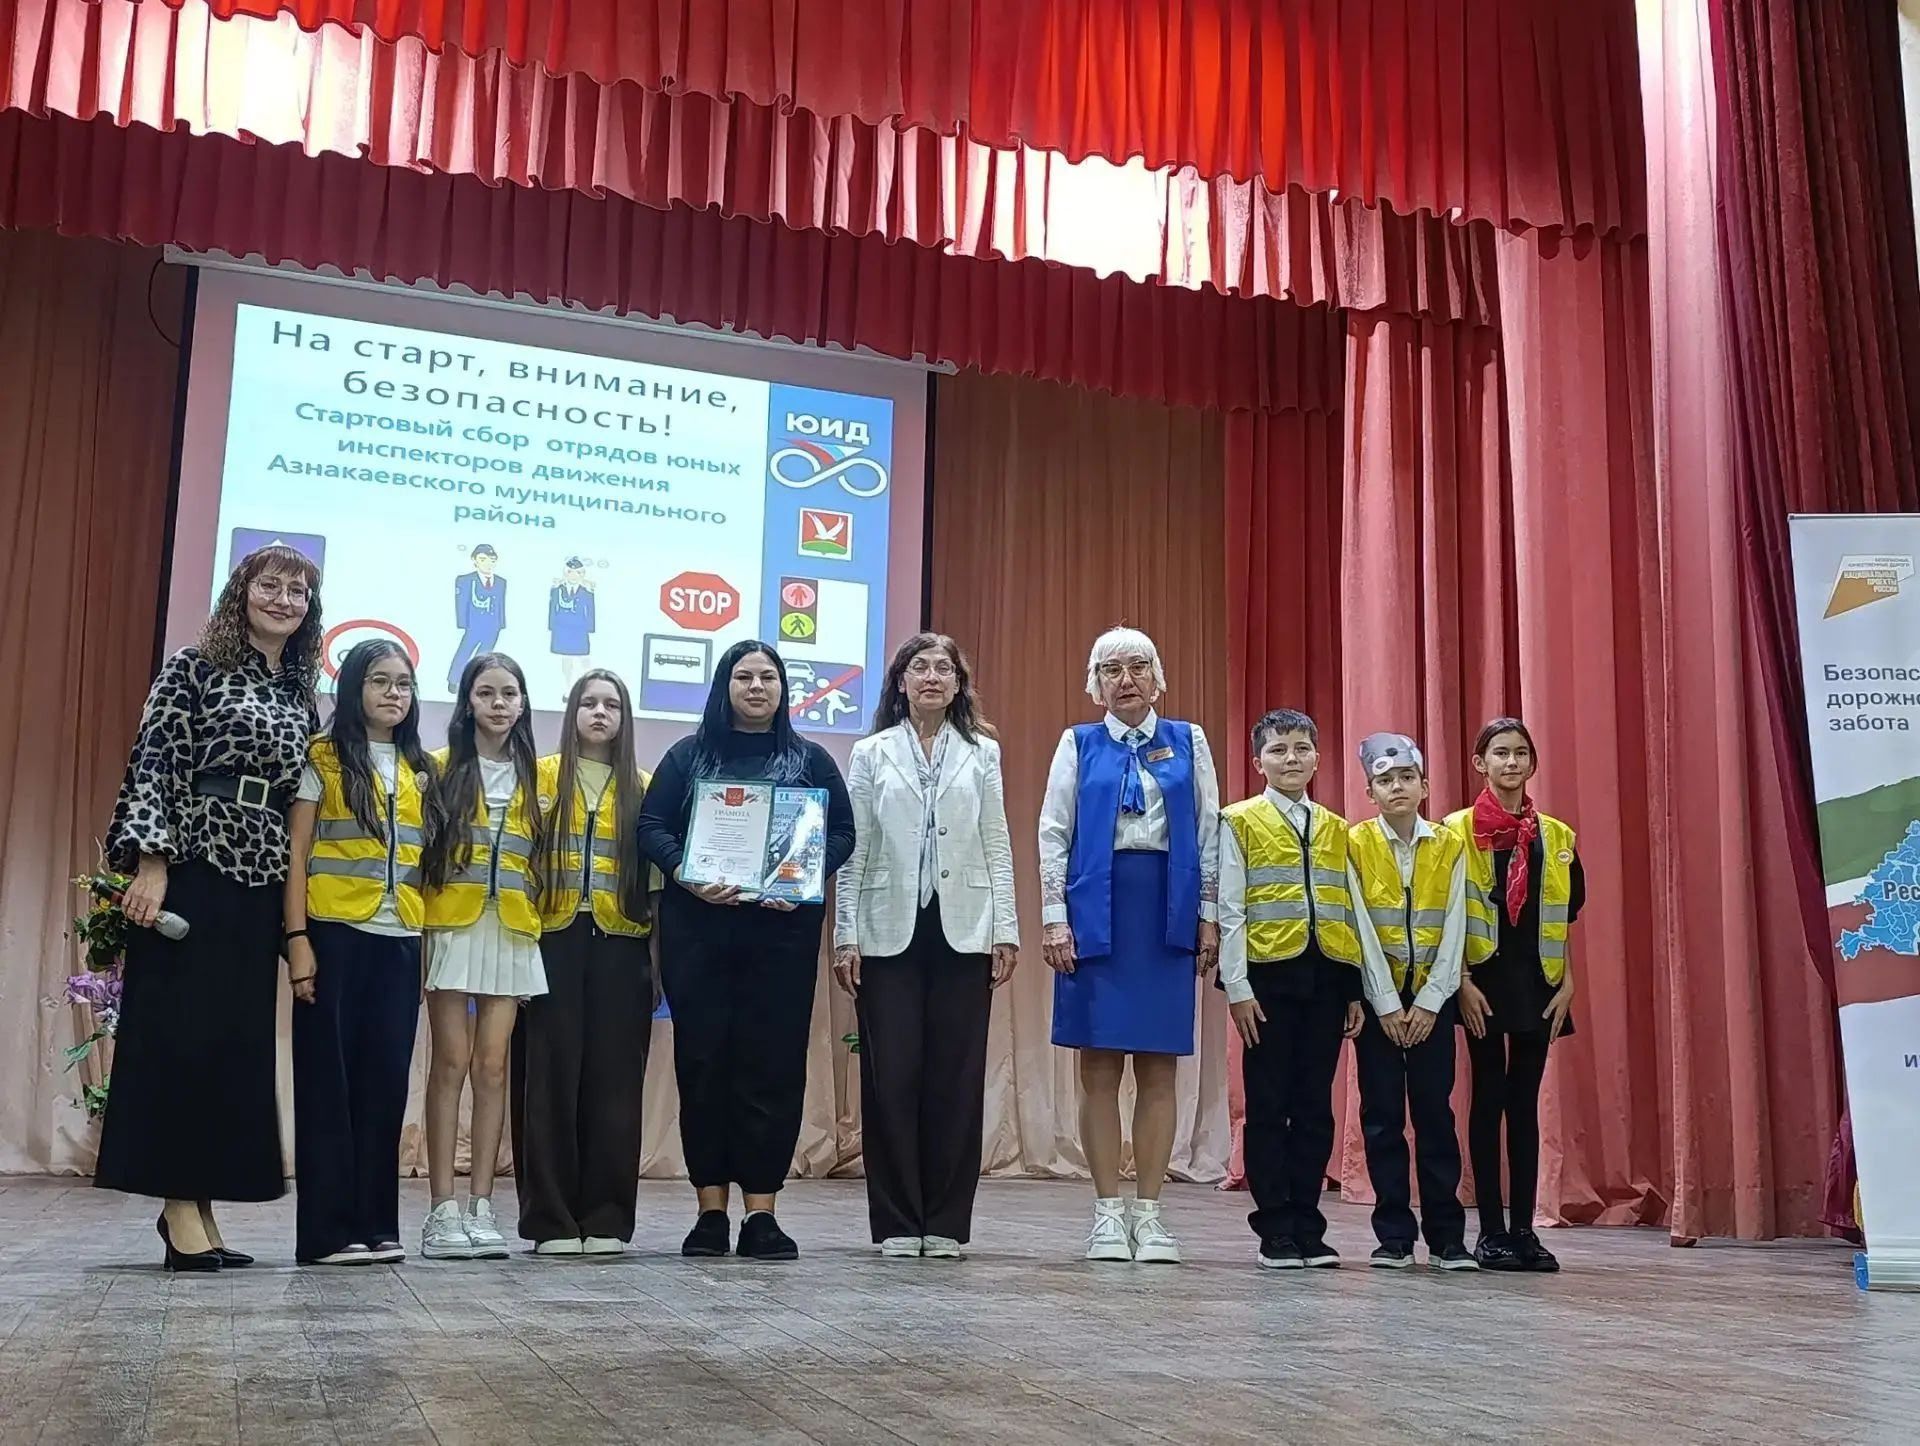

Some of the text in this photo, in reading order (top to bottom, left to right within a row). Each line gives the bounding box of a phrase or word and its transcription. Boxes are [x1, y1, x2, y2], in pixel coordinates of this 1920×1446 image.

[272, 321, 738, 413] На старт, внимание,
[343, 370, 672, 436] безопасность!
[295, 402, 742, 477] Стартовый сбор отрядов юных
[786, 412, 871, 446] ЮИД
[338, 439, 670, 493] инспекторов движения
[267, 454, 727, 525] Азнакаевского муниципального
[453, 504, 556, 529] района
[669, 587, 732, 615] STOP
[1823, 664, 1920, 681] Безопас
[1829, 714, 1910, 732] забота
